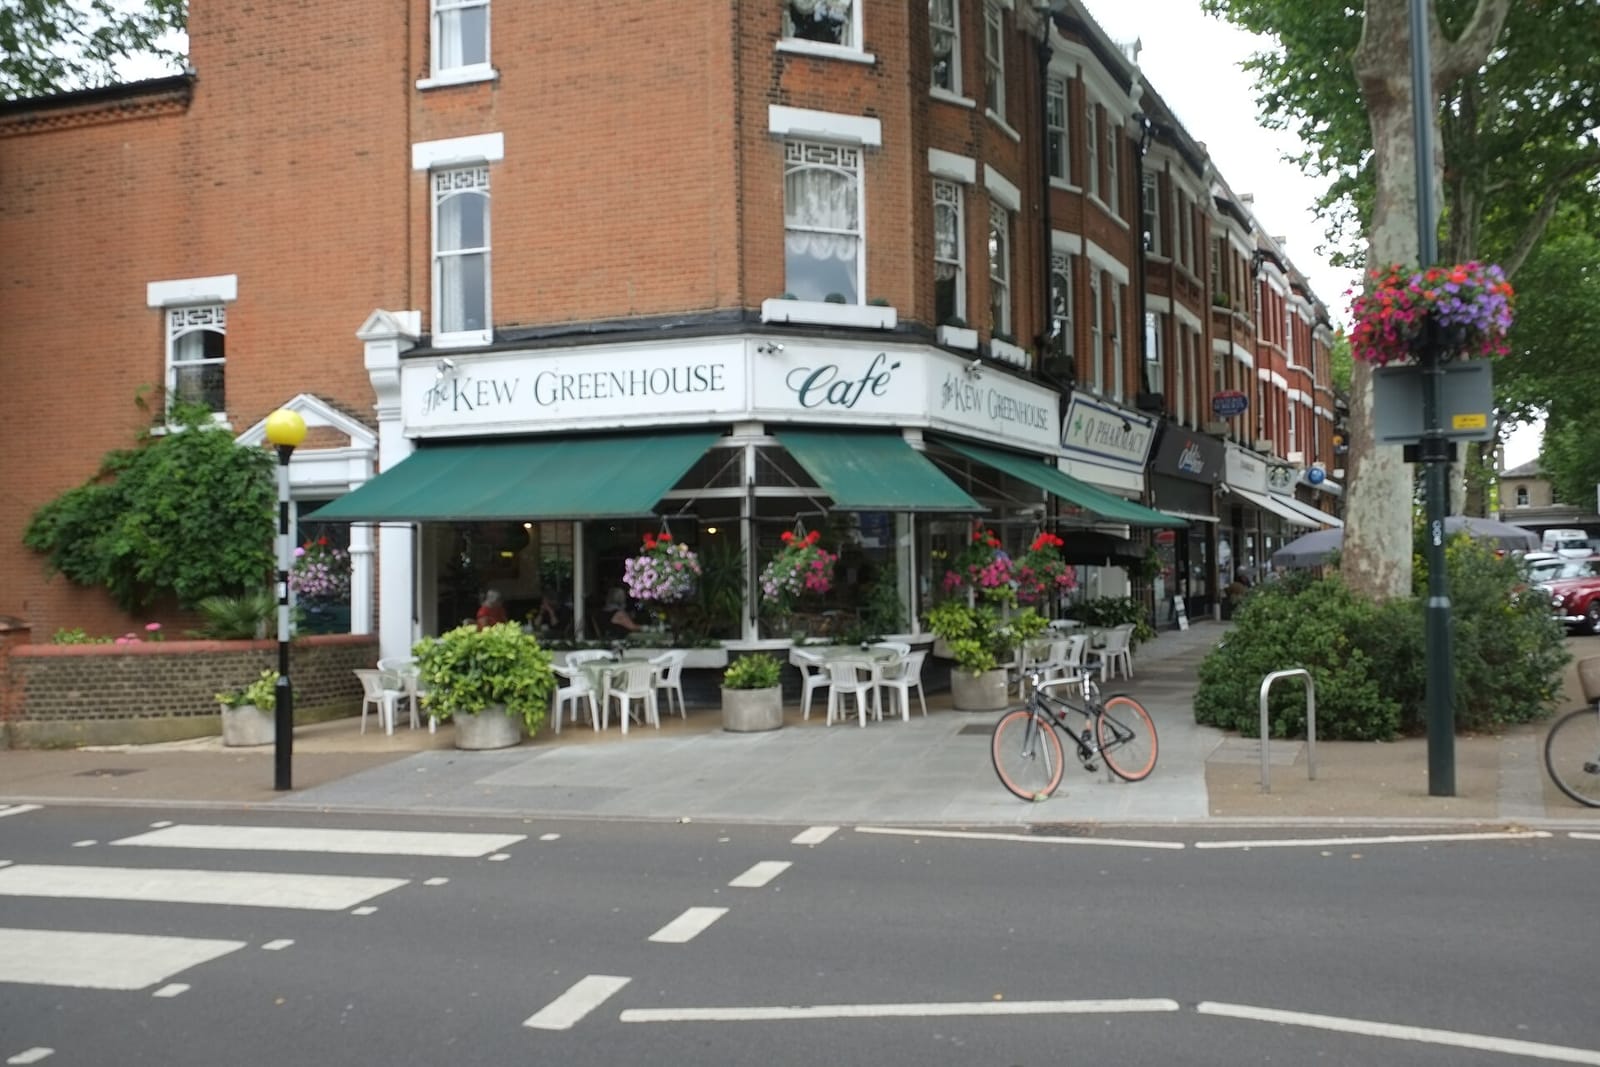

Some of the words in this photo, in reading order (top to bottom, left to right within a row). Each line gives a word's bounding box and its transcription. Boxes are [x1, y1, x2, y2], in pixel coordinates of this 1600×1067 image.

[453, 376, 519, 412] KEW
[534, 364, 726, 406] GREENHOUSE
[785, 352, 901, 409] Café
[954, 377, 984, 412] KEW
[987, 388, 1049, 431] GREENHOUSE
